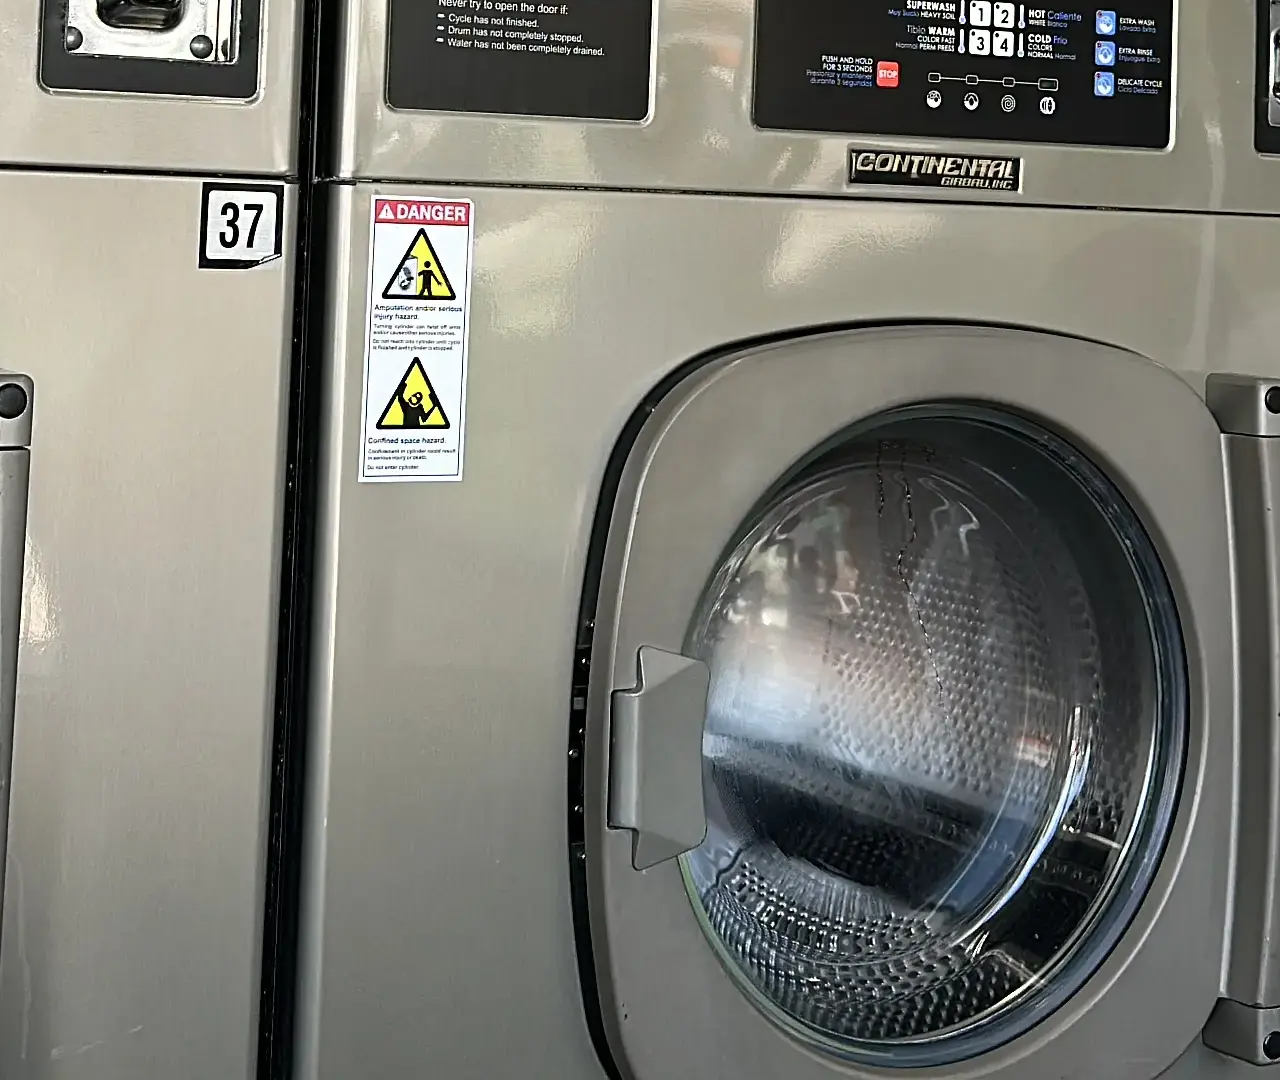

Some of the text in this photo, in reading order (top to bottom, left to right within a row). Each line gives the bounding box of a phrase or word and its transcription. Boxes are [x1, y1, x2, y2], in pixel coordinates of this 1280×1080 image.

[907, 0, 955, 12] SUPERWASH
[1029, 9, 1045, 19] HOT
[928, 26, 955, 36] WARM
[1028, 34, 1052, 43] COLD
[856, 153, 1014, 178] CONTINENTAL
[396, 204, 466, 221] DANGER
[220, 204, 264, 248] 37
